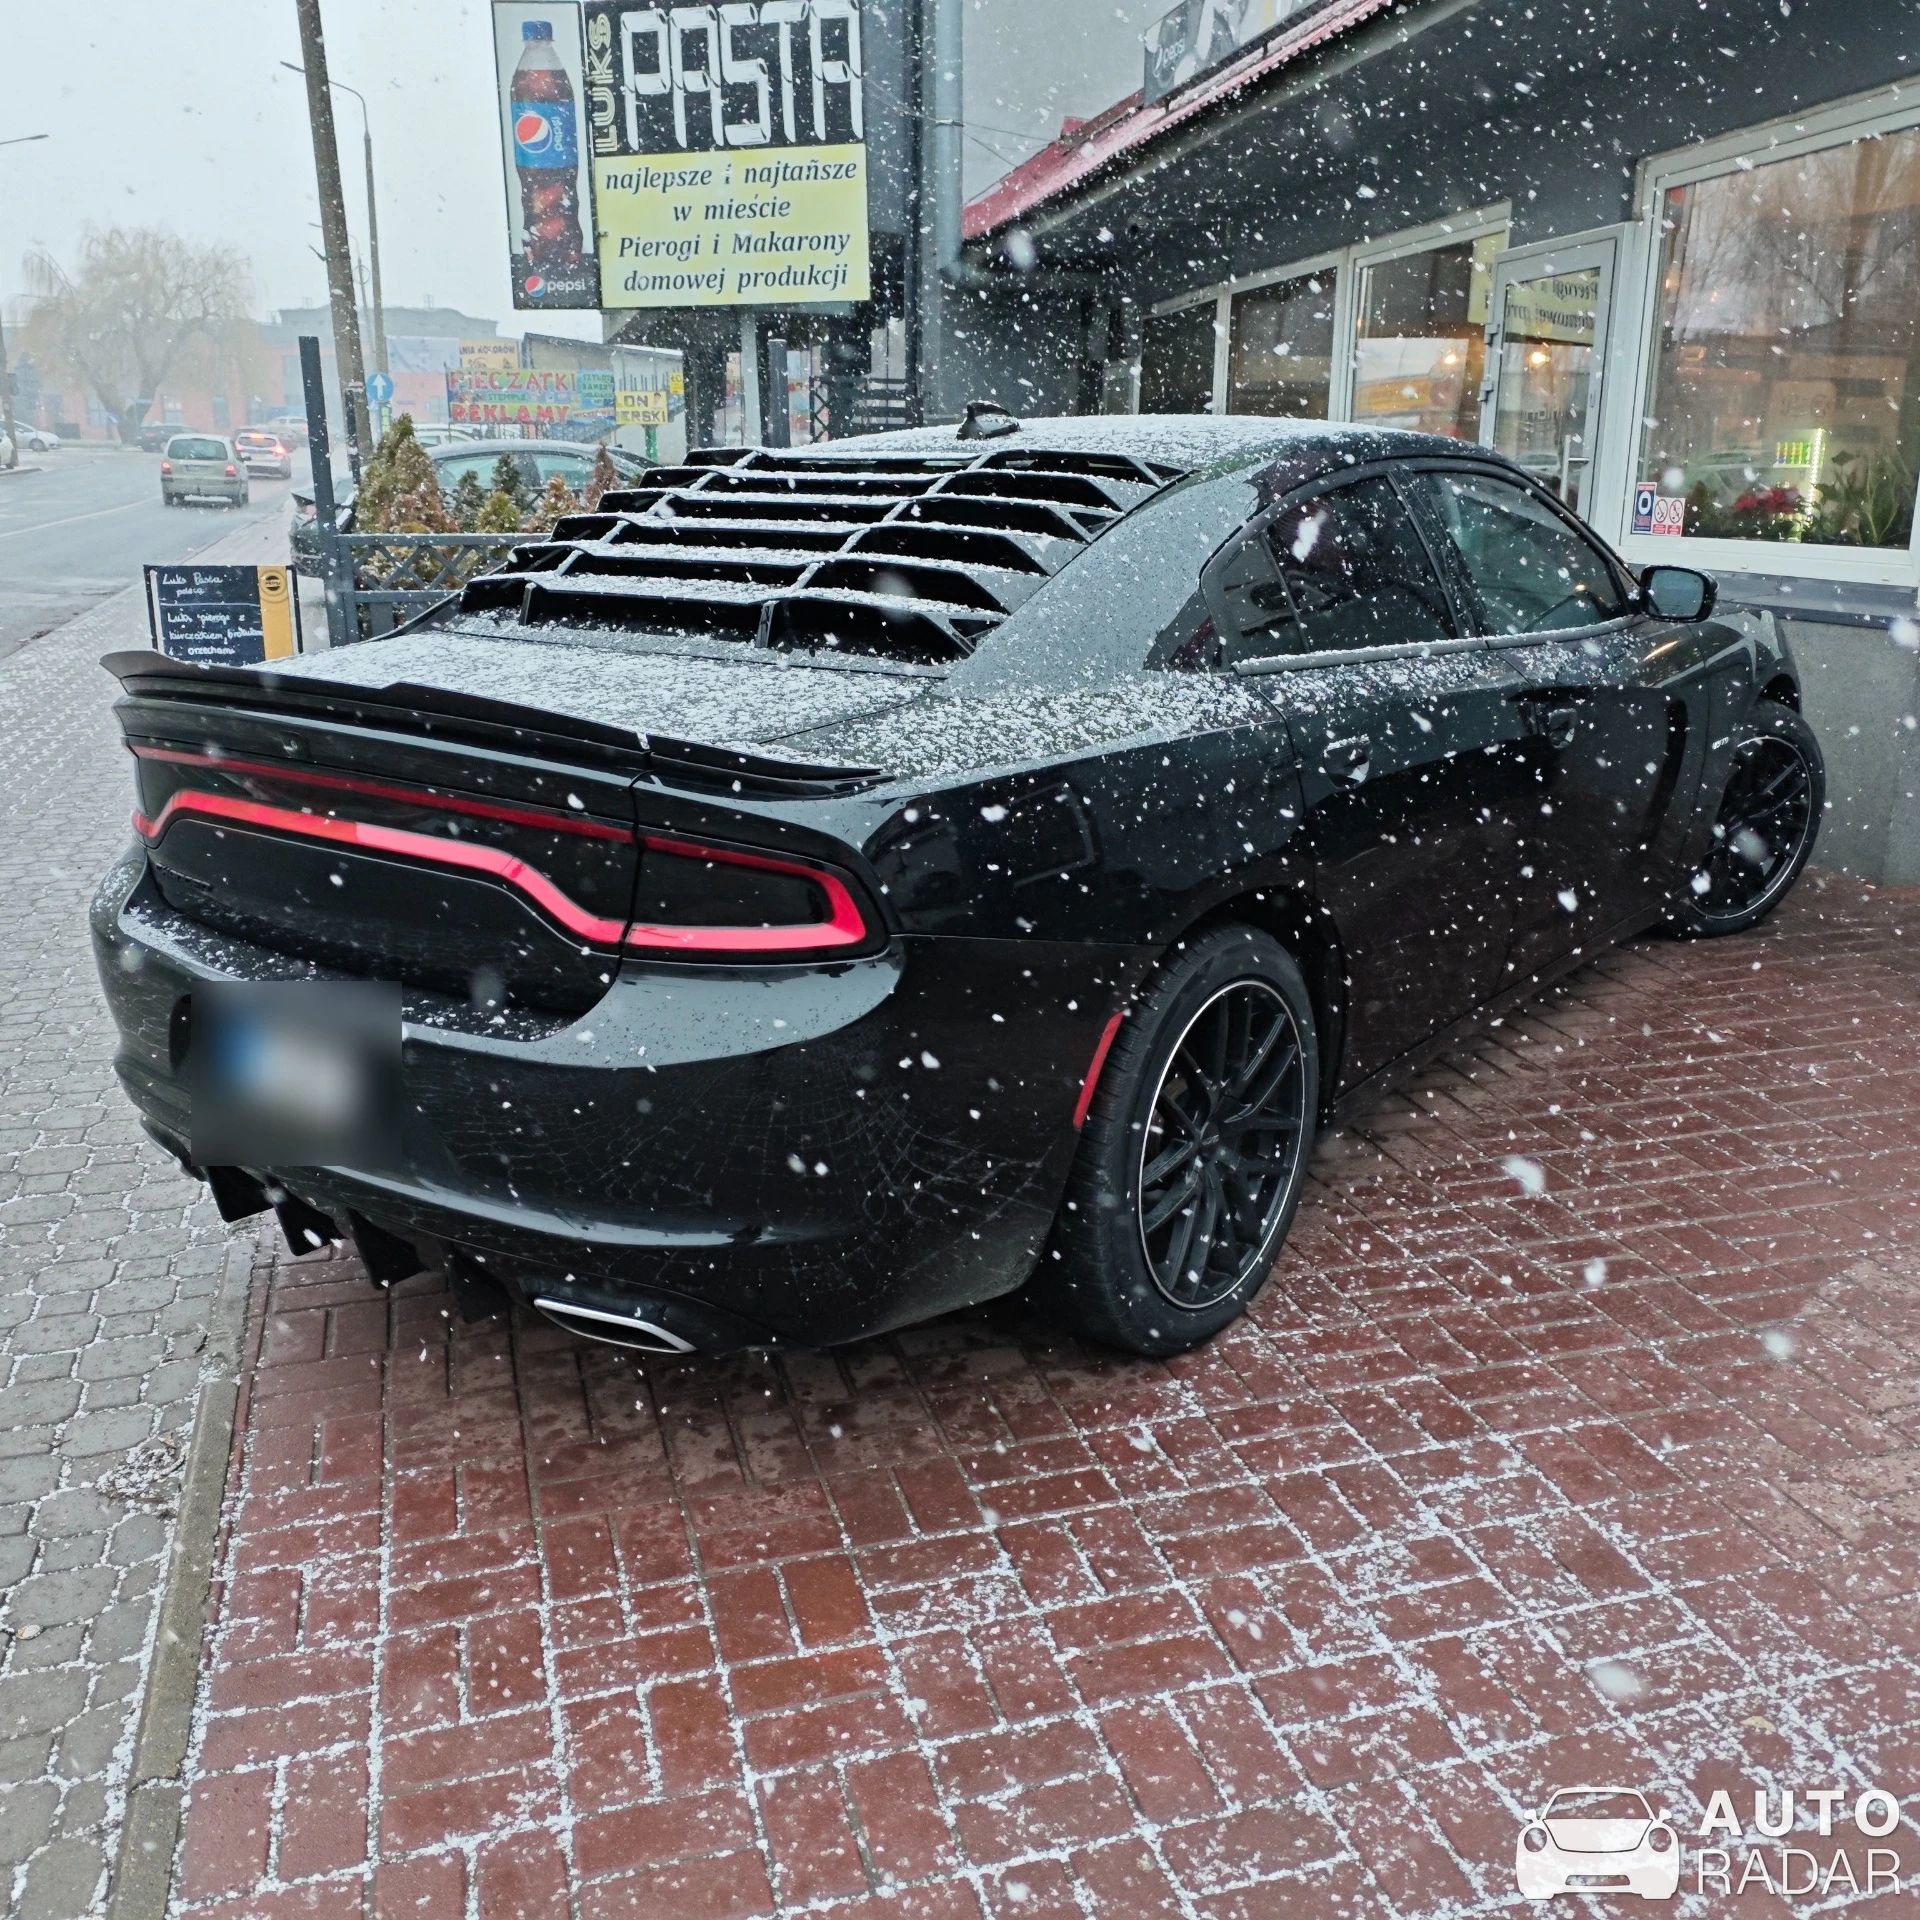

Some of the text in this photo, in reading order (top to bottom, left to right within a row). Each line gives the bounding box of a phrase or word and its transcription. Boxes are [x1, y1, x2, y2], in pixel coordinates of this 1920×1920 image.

[588, 12, 618, 153] LUKS
[620, 0, 863, 151] PASTA
[551, 116, 564, 151] pepsi
[605, 164, 713, 198] najlepsze
[672, 193, 791, 222] w mieście
[618, 231, 851, 262] Pierogi i Makarony
[547, 278, 586, 293] pepsi
[624, 264, 848, 294] domowej produkcji
[452, 404, 569, 423] REKLAMY
[162, 571, 223, 586] Luks Pasta
